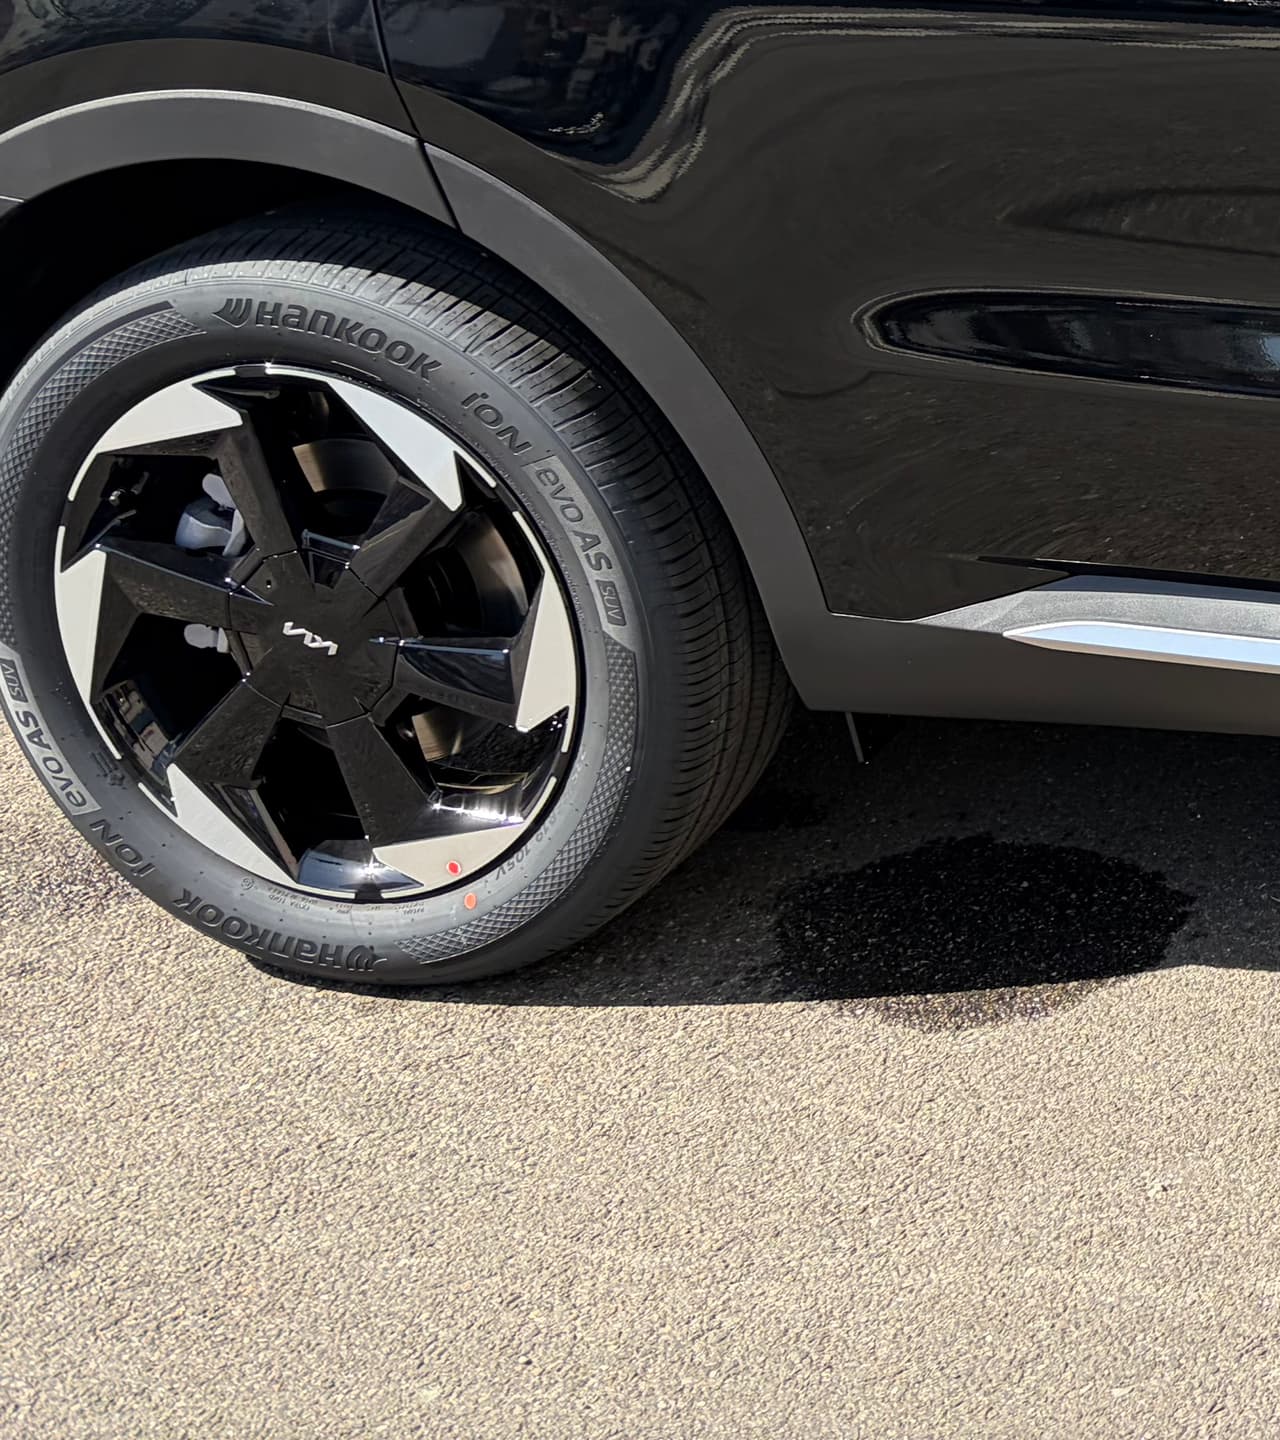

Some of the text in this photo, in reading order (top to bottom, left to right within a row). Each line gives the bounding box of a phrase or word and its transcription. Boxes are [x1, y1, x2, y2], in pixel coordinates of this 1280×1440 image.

[572, 530, 614, 571] AS
[600, 583, 625, 627] SUV
[1, 661, 25, 703] SUV
[15, 709, 52, 751] AS
